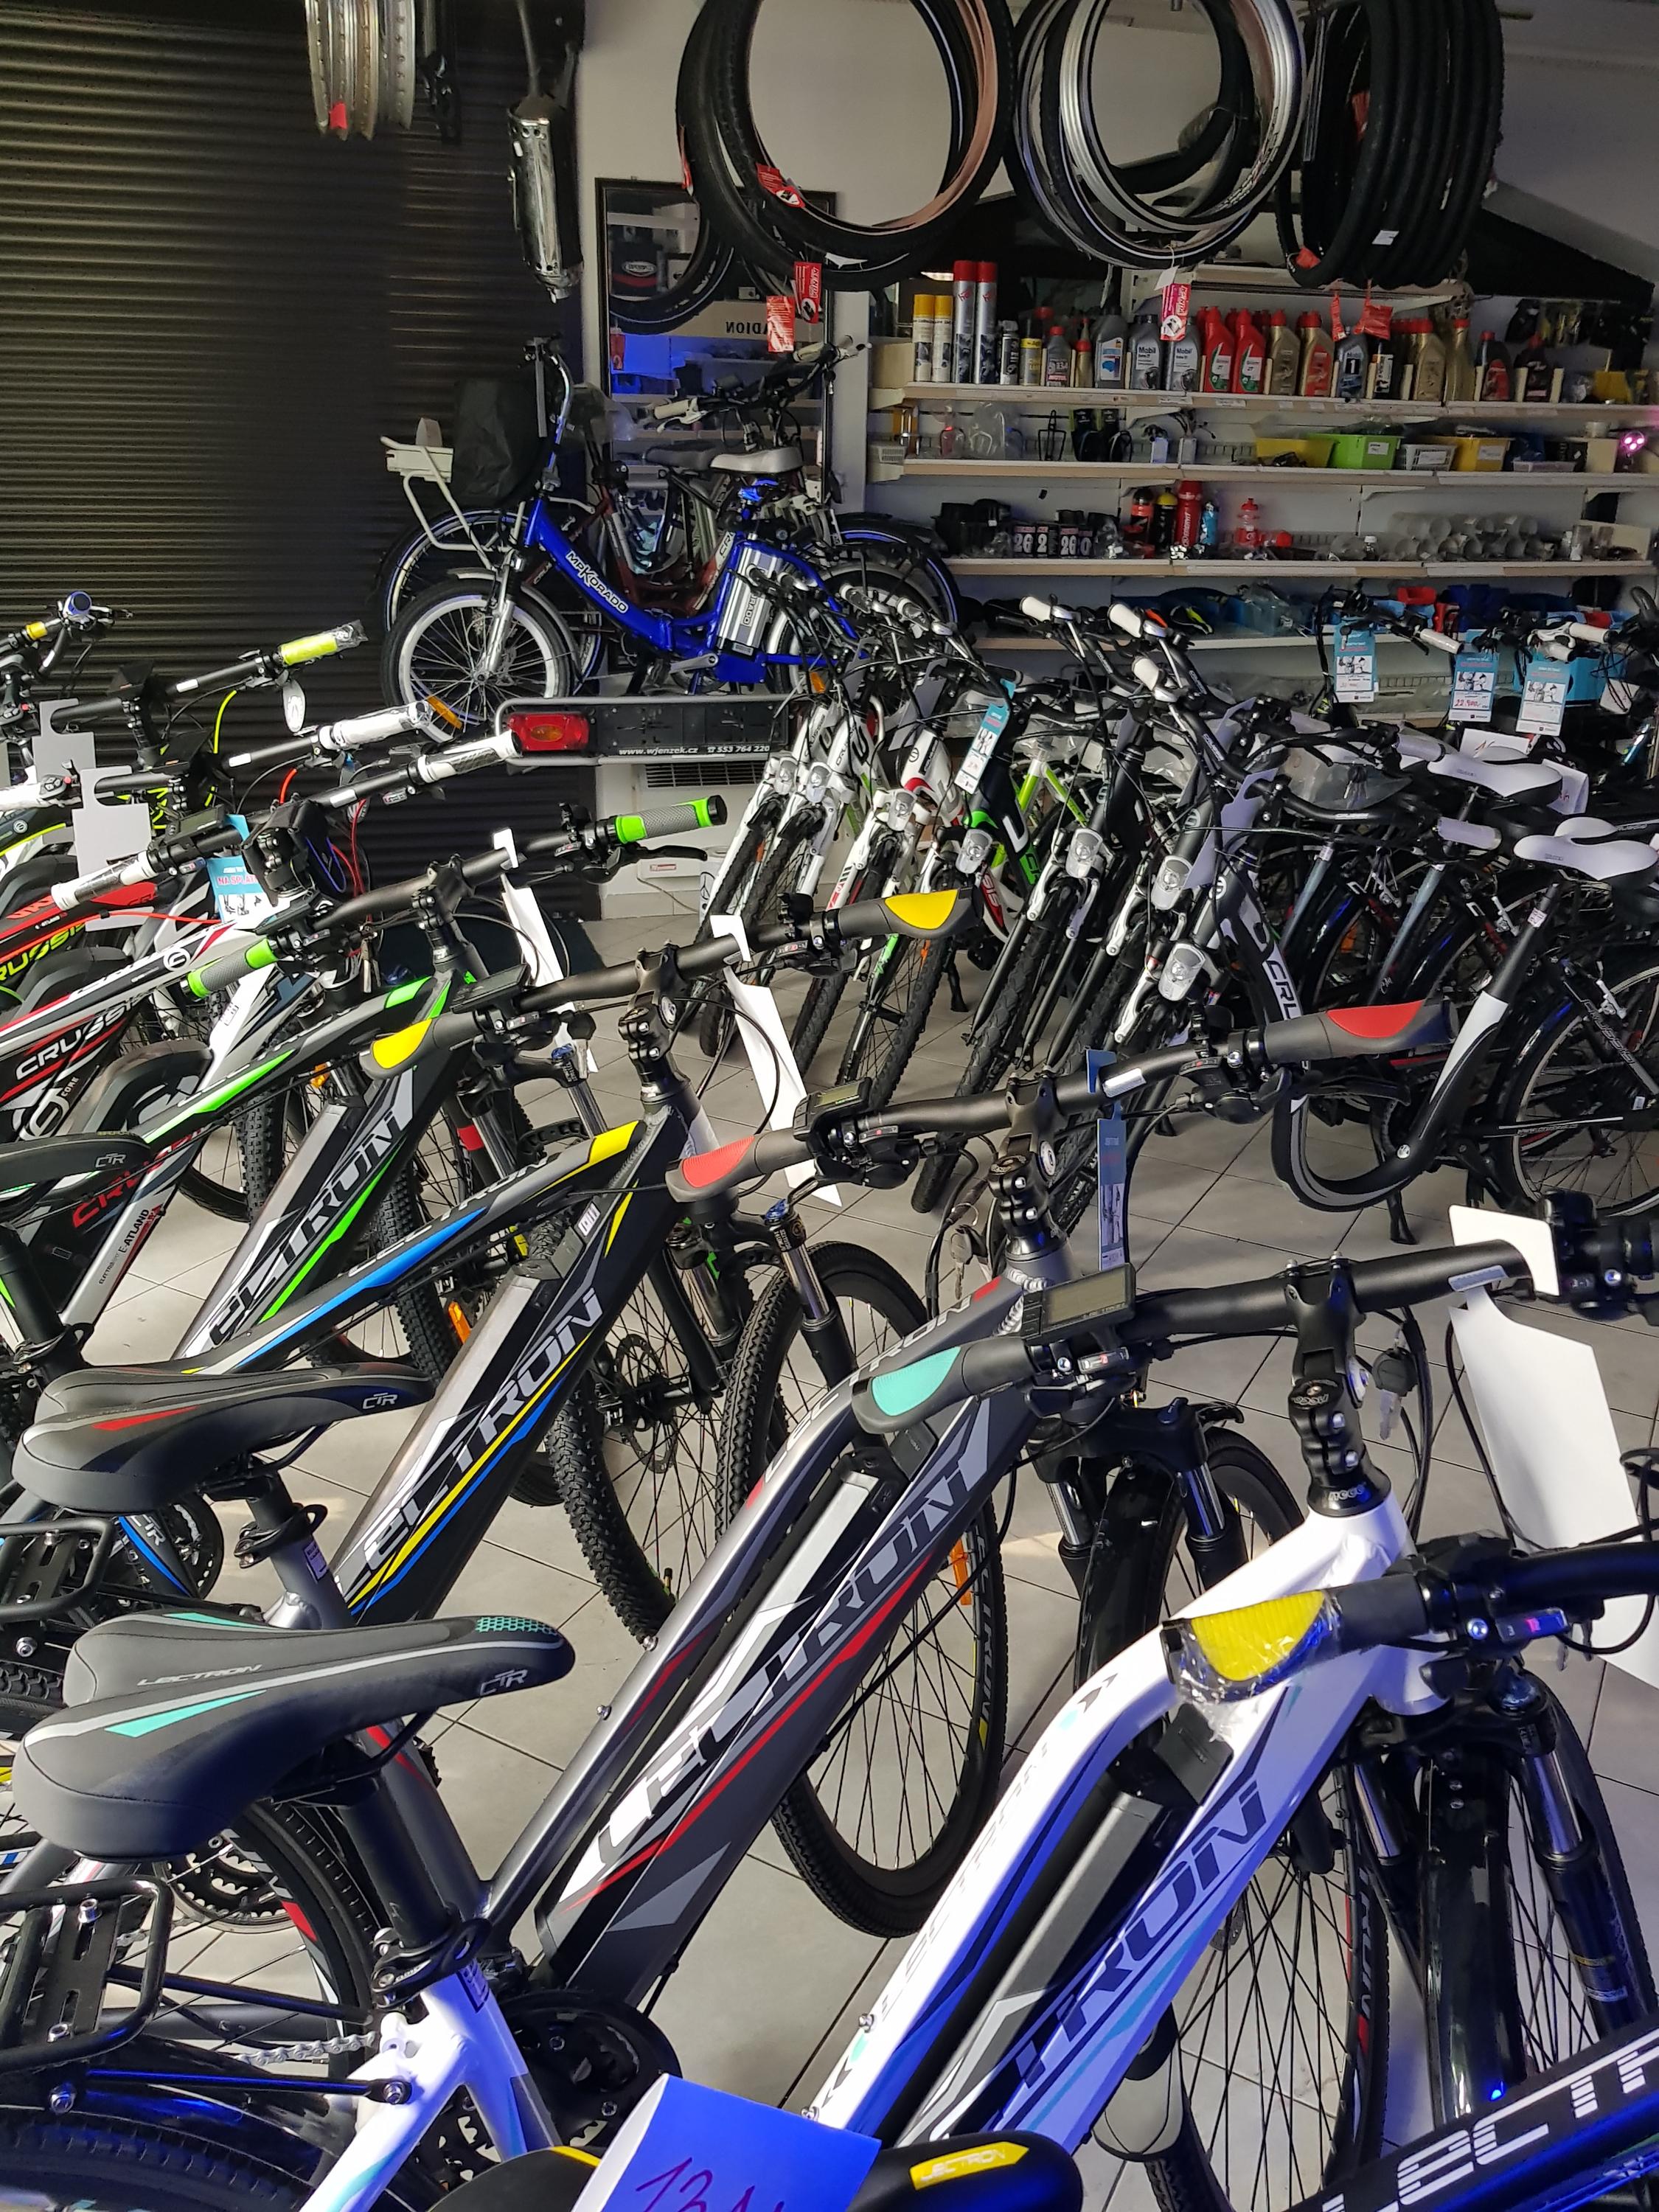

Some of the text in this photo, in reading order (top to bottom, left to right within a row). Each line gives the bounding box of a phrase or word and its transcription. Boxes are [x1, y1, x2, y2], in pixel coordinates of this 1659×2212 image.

[619, 747, 699, 756] www.wjenzek.cz
[95, 1152, 127, 1169] CTR
[363, 1392, 398, 1410] CTR
[479, 1668, 529, 1697] CTR
